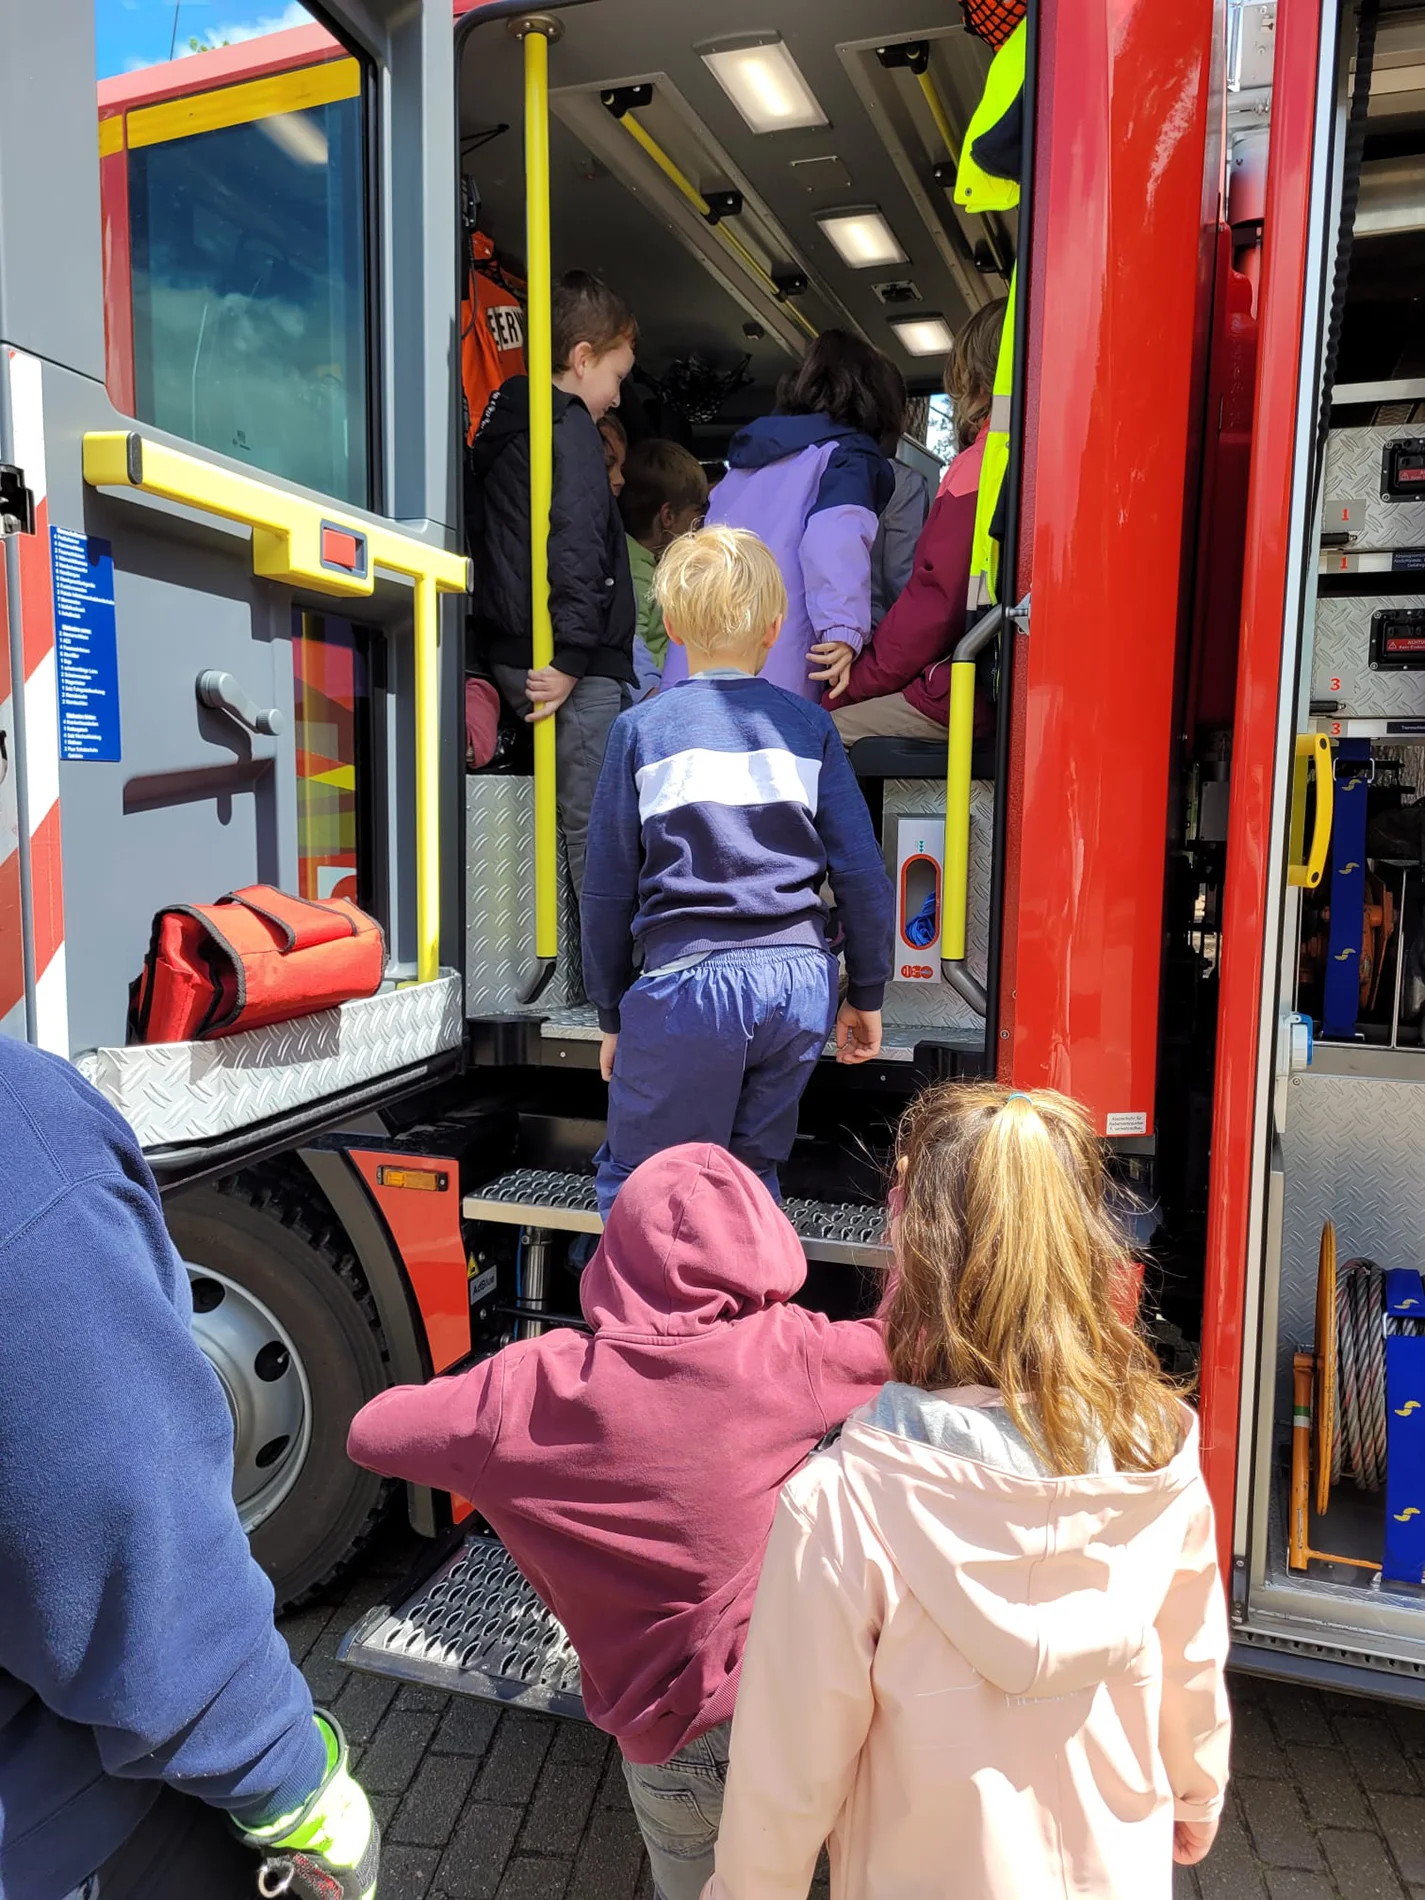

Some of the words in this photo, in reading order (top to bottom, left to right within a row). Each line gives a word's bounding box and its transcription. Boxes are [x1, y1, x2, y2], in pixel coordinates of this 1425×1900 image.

[1342, 507, 1349, 521] 1
[1340, 556, 1348, 569] 1
[1329, 677, 1341, 691] 3
[1330, 722, 1341, 735] 3
